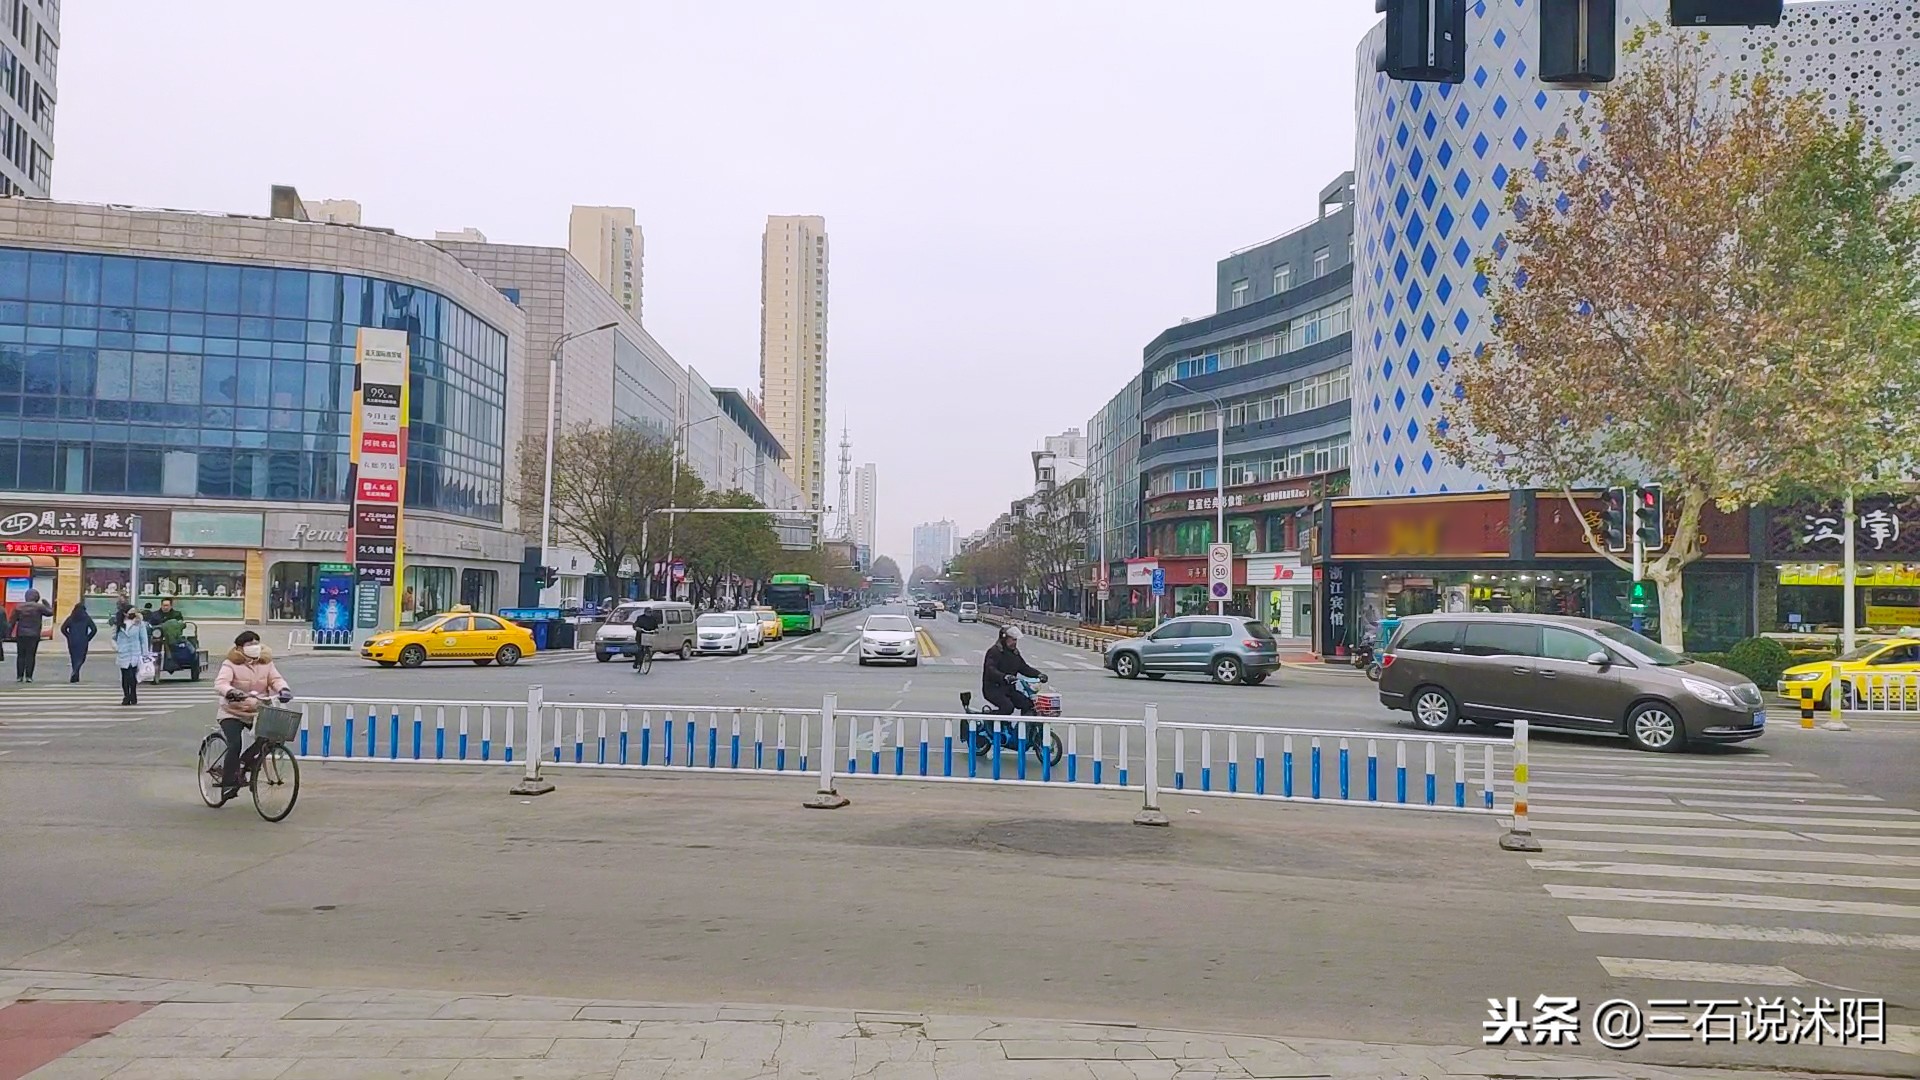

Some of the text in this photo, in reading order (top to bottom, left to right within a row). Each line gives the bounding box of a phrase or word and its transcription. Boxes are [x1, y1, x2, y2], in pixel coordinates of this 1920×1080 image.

[38, 528, 64, 536] ZHOU
[1215, 567, 1226, 576] 50
[1328, 566, 1345, 627] 浙江宾馆
